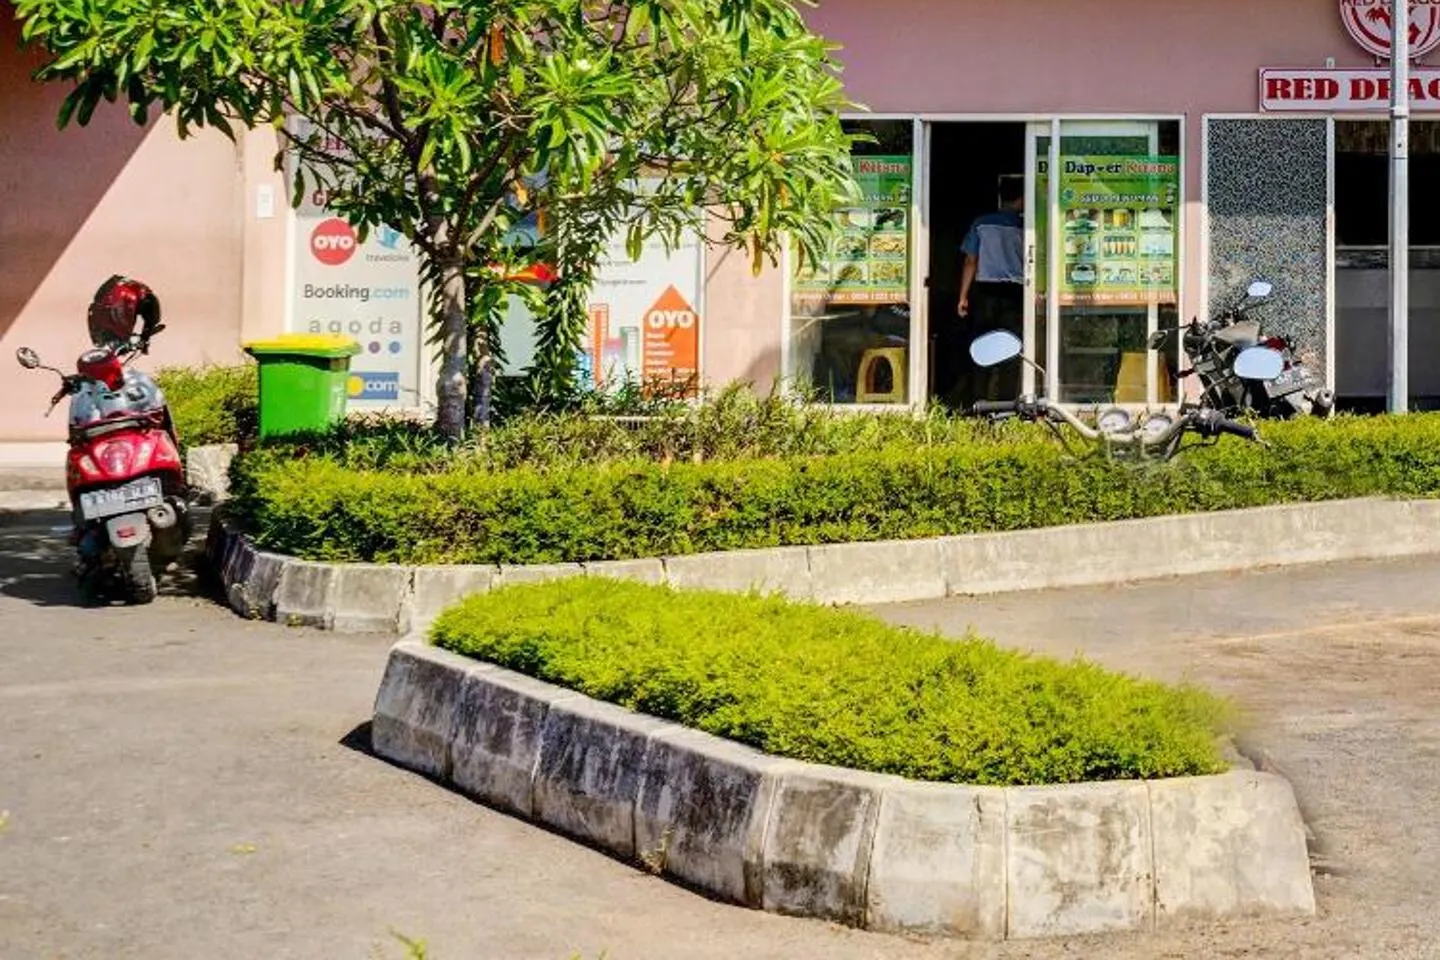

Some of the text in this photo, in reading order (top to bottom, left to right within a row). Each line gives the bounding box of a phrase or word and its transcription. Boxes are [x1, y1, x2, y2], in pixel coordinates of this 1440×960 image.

[1265, 77, 1339, 100] RED
[313, 235, 355, 249] OYO
[303, 283, 410, 302] Booking.com
[308, 317, 402, 337] agoda
[648, 310, 695, 328] OYO
